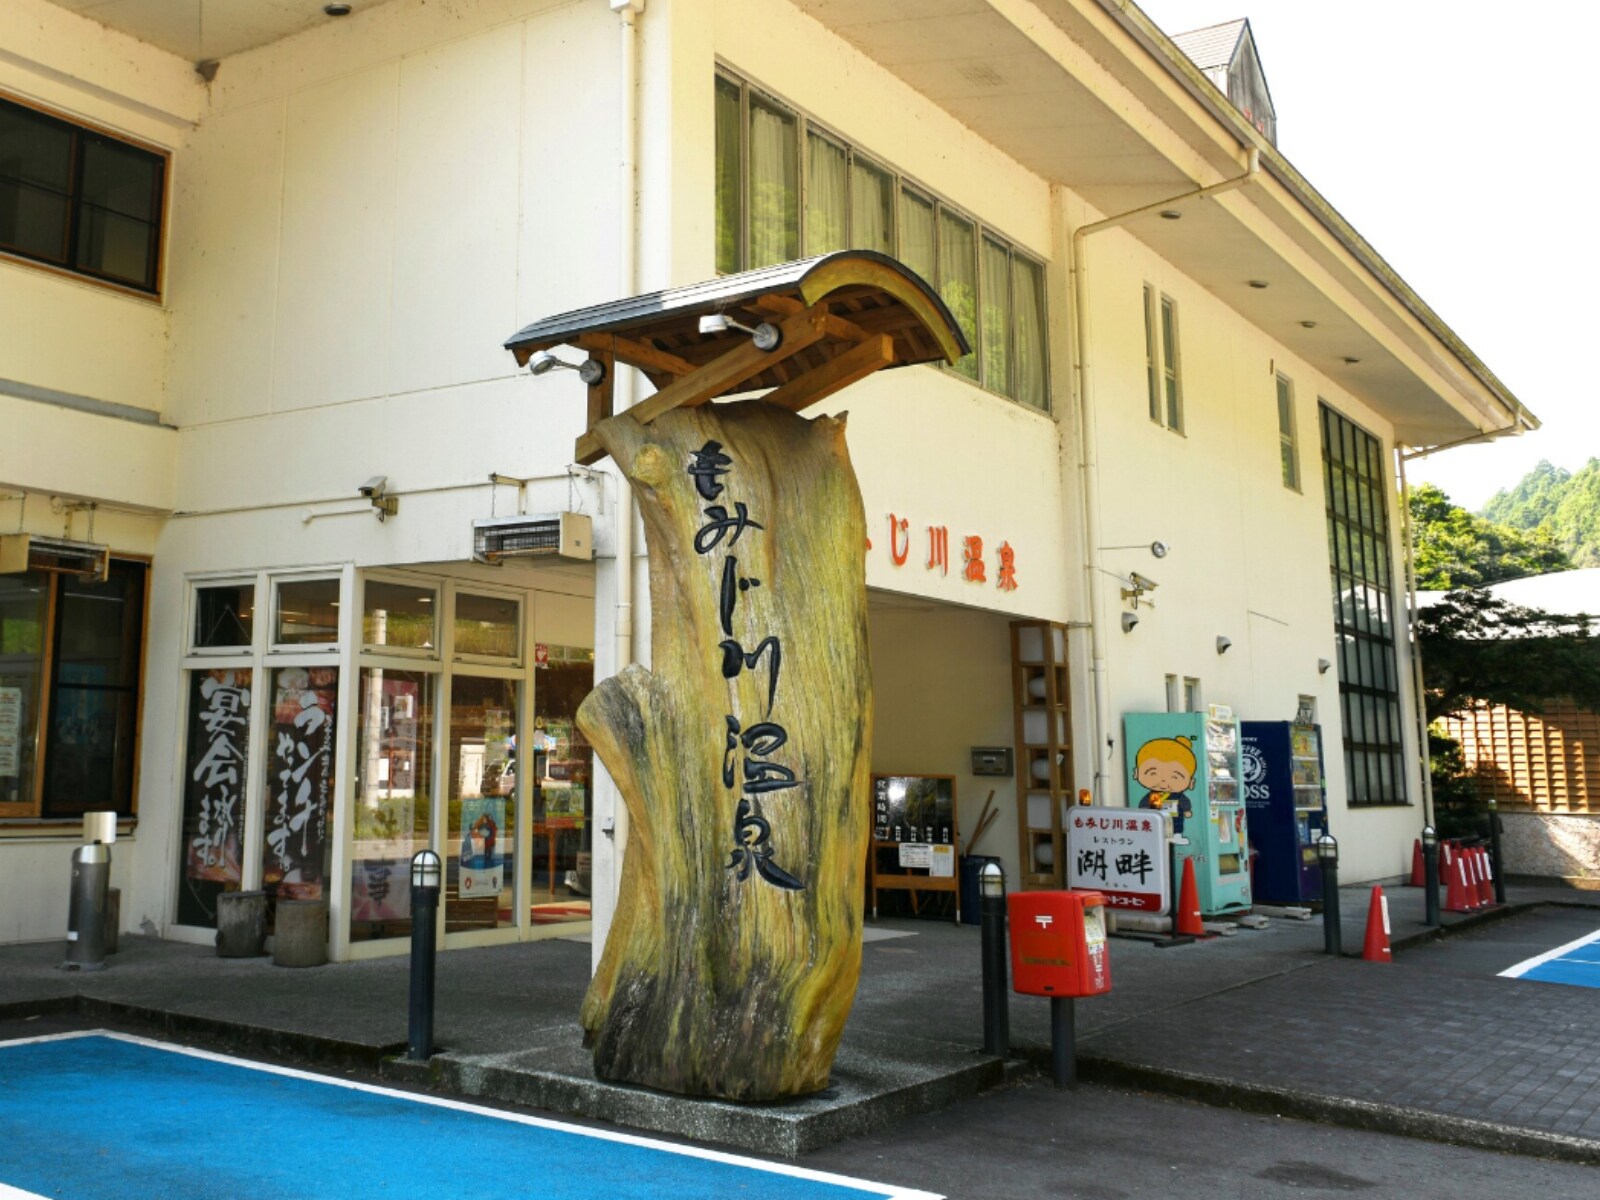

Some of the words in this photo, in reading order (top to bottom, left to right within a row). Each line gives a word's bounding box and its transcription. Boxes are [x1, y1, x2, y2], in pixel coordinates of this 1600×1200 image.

[866, 512, 1018, 592] じ川温泉
[688, 440, 806, 890] もみじ川温泉
[1074, 816, 1152, 832] もみじ川温泉
[1093, 836, 1134, 845] レストラン
[1077, 848, 1154, 885] 湖畔
